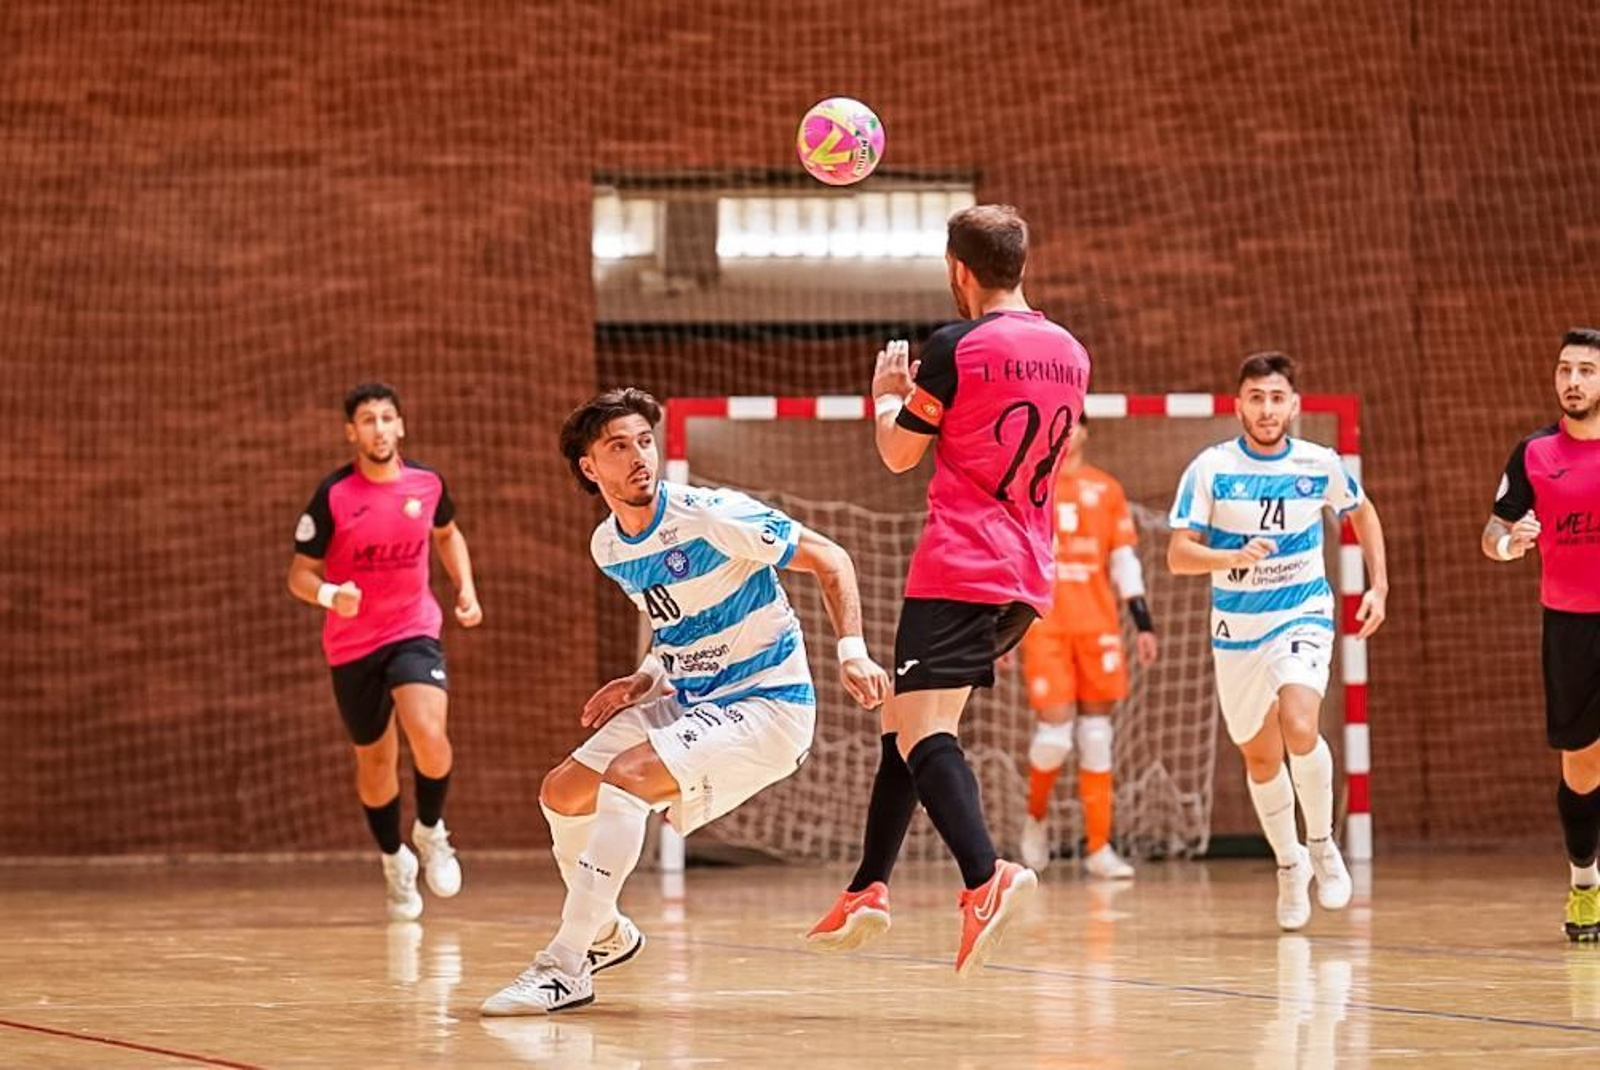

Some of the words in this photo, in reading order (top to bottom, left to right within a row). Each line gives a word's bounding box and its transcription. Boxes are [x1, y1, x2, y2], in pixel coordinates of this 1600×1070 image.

[994, 401, 1073, 508] 28
[1260, 497, 1285, 530] 24
[643, 583, 681, 622] 48
